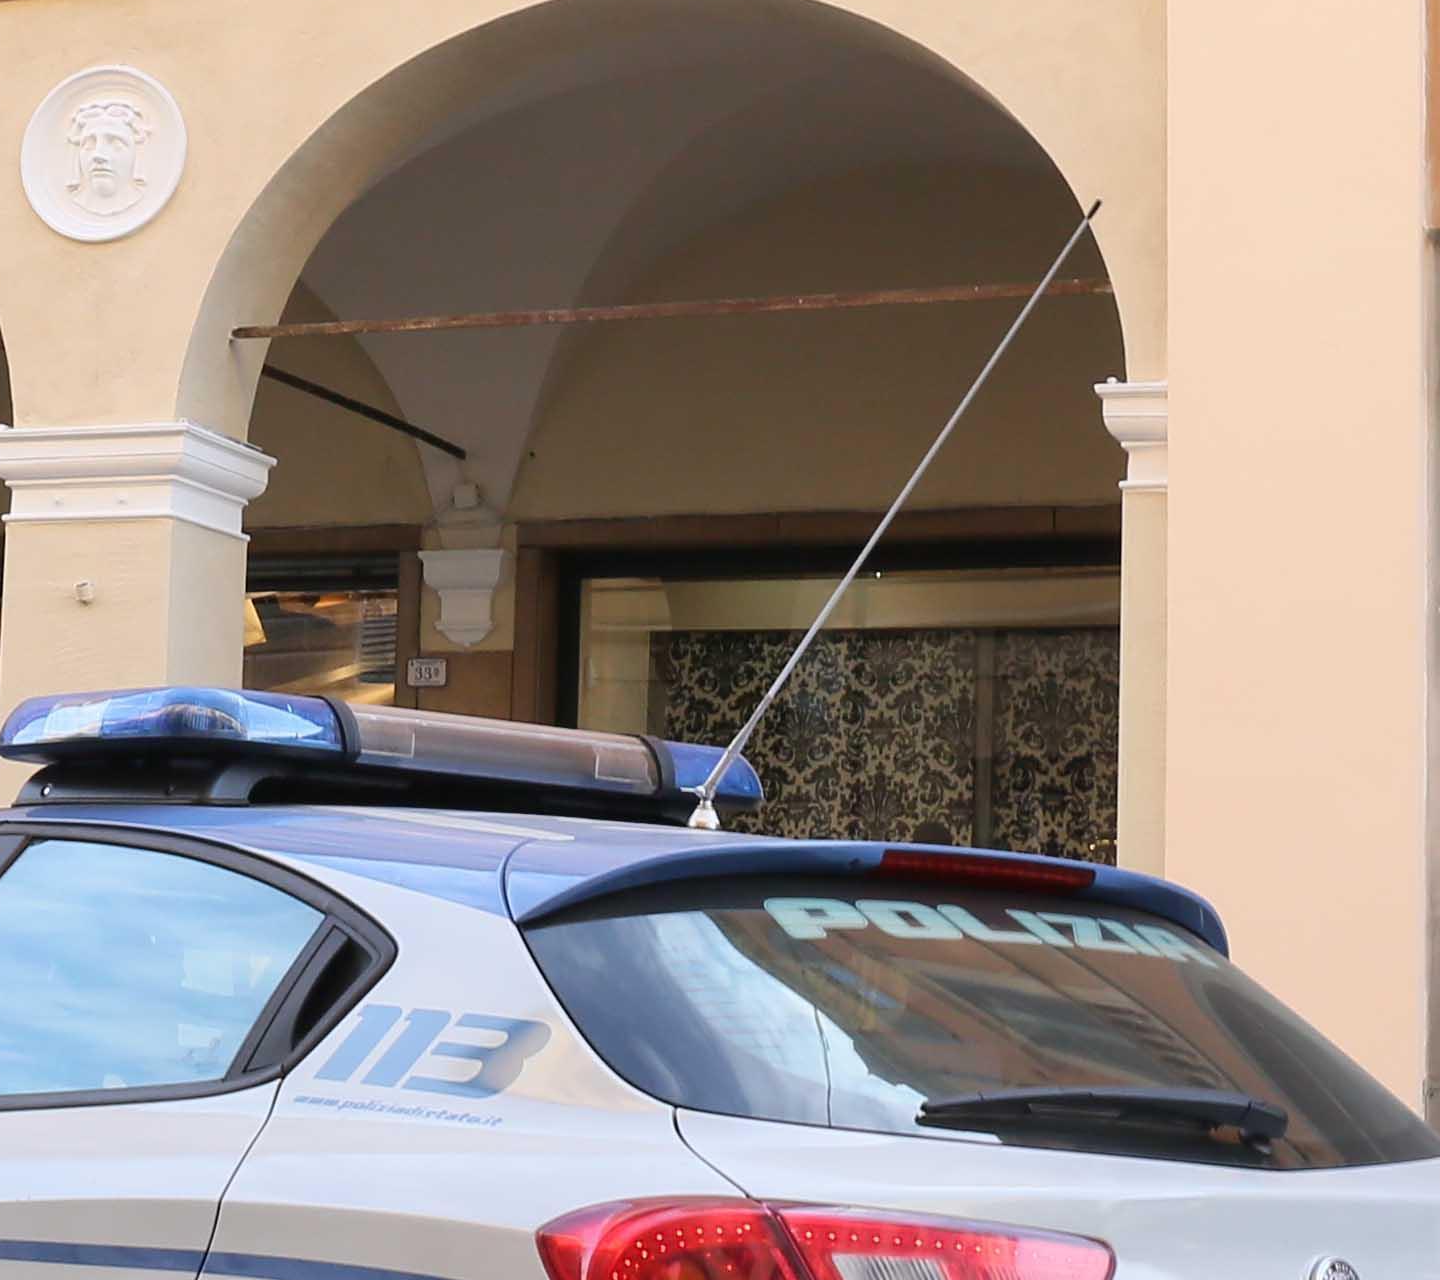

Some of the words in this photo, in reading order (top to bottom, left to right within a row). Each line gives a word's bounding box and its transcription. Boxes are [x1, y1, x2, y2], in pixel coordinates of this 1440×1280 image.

[763, 897, 1220, 970] POLIZIA
[313, 1003, 552, 1100] 113
[293, 1094, 503, 1127] www.poliziadistato.it
